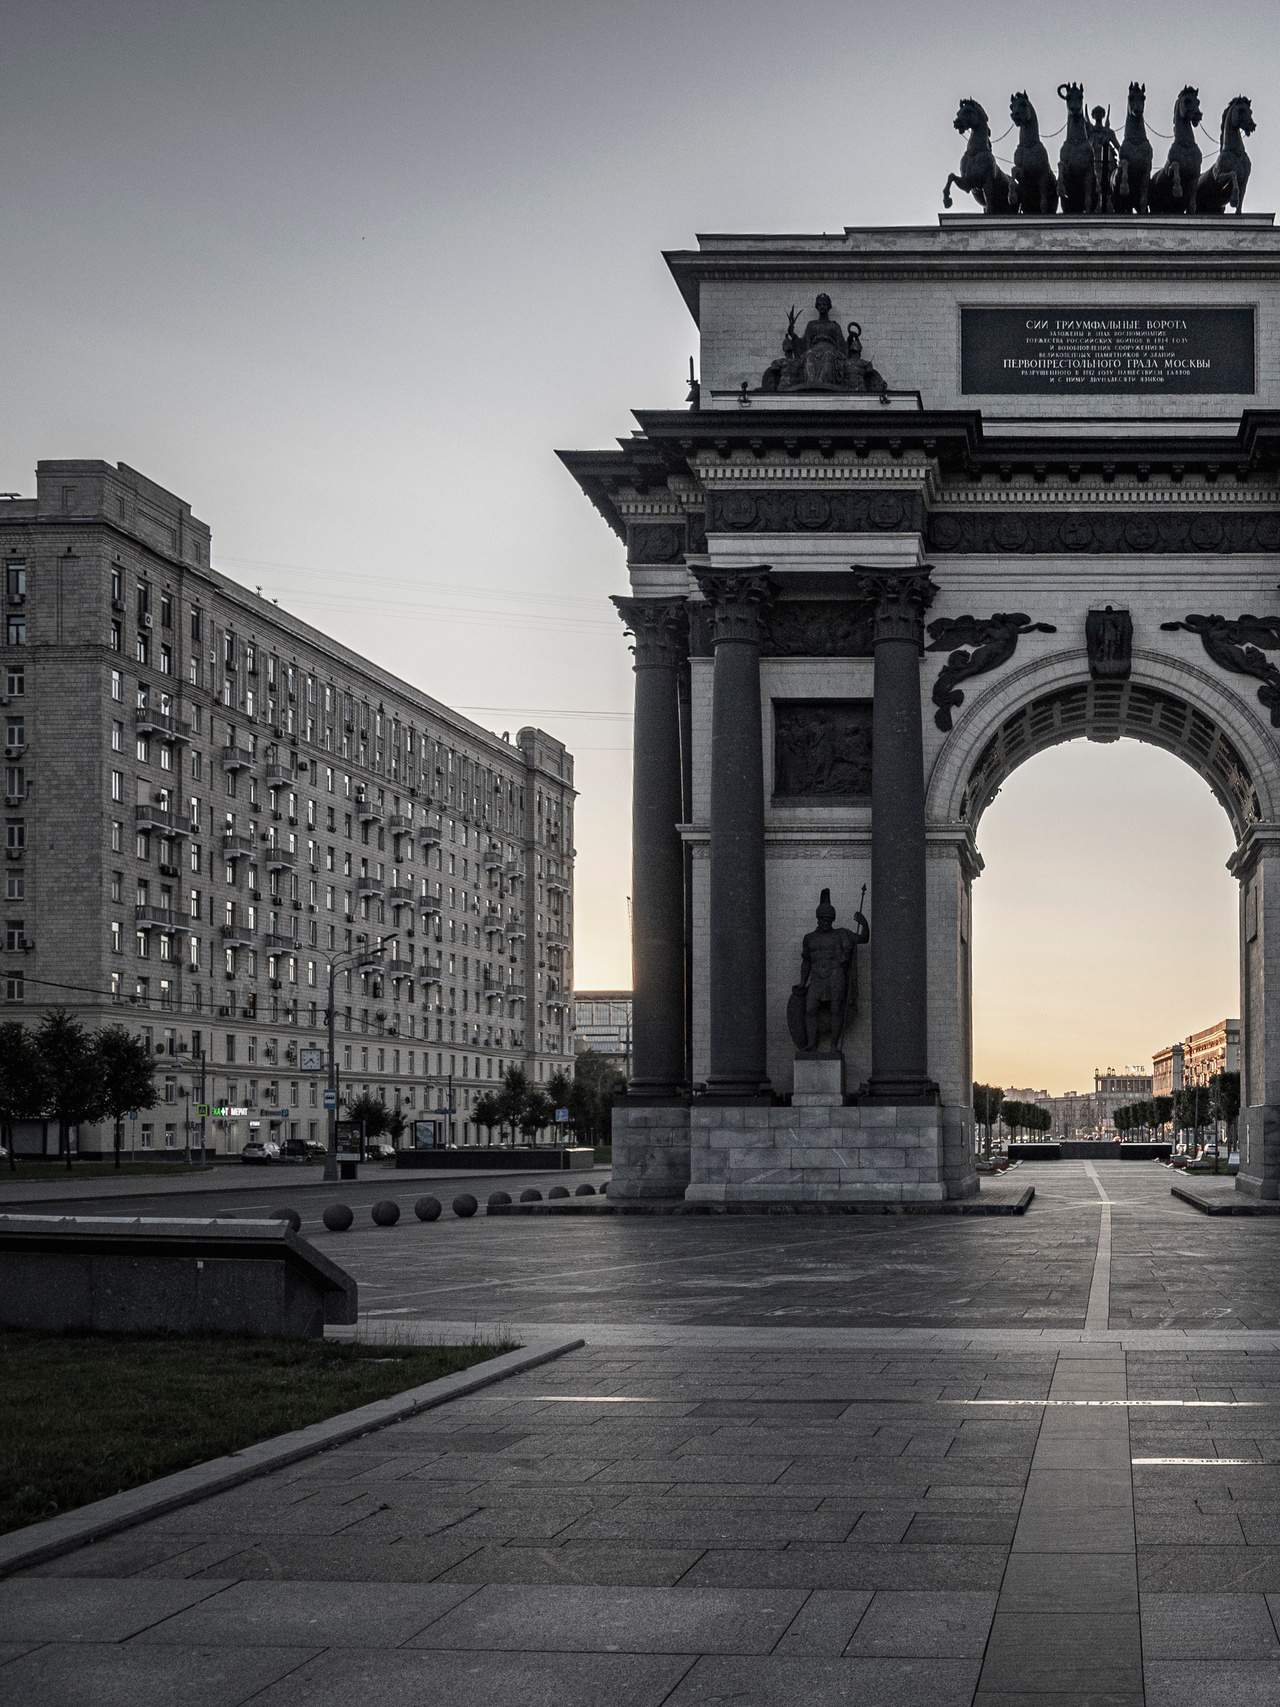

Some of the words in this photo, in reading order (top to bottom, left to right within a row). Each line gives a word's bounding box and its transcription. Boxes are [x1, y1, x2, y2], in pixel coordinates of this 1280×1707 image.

[1025, 320, 1049, 329] СИИ
[1055, 320, 1141, 329] ТРИУМФАЛЬНЫЕ
[1146, 320, 1187, 329] ВОРОТА
[1003, 359, 1121, 368] ПЕРВОПРЕСТОЛЬНОГО
[1127, 359, 1158, 368] ГРАДА
[1164, 359, 1211, 368] МОСКВЫ
